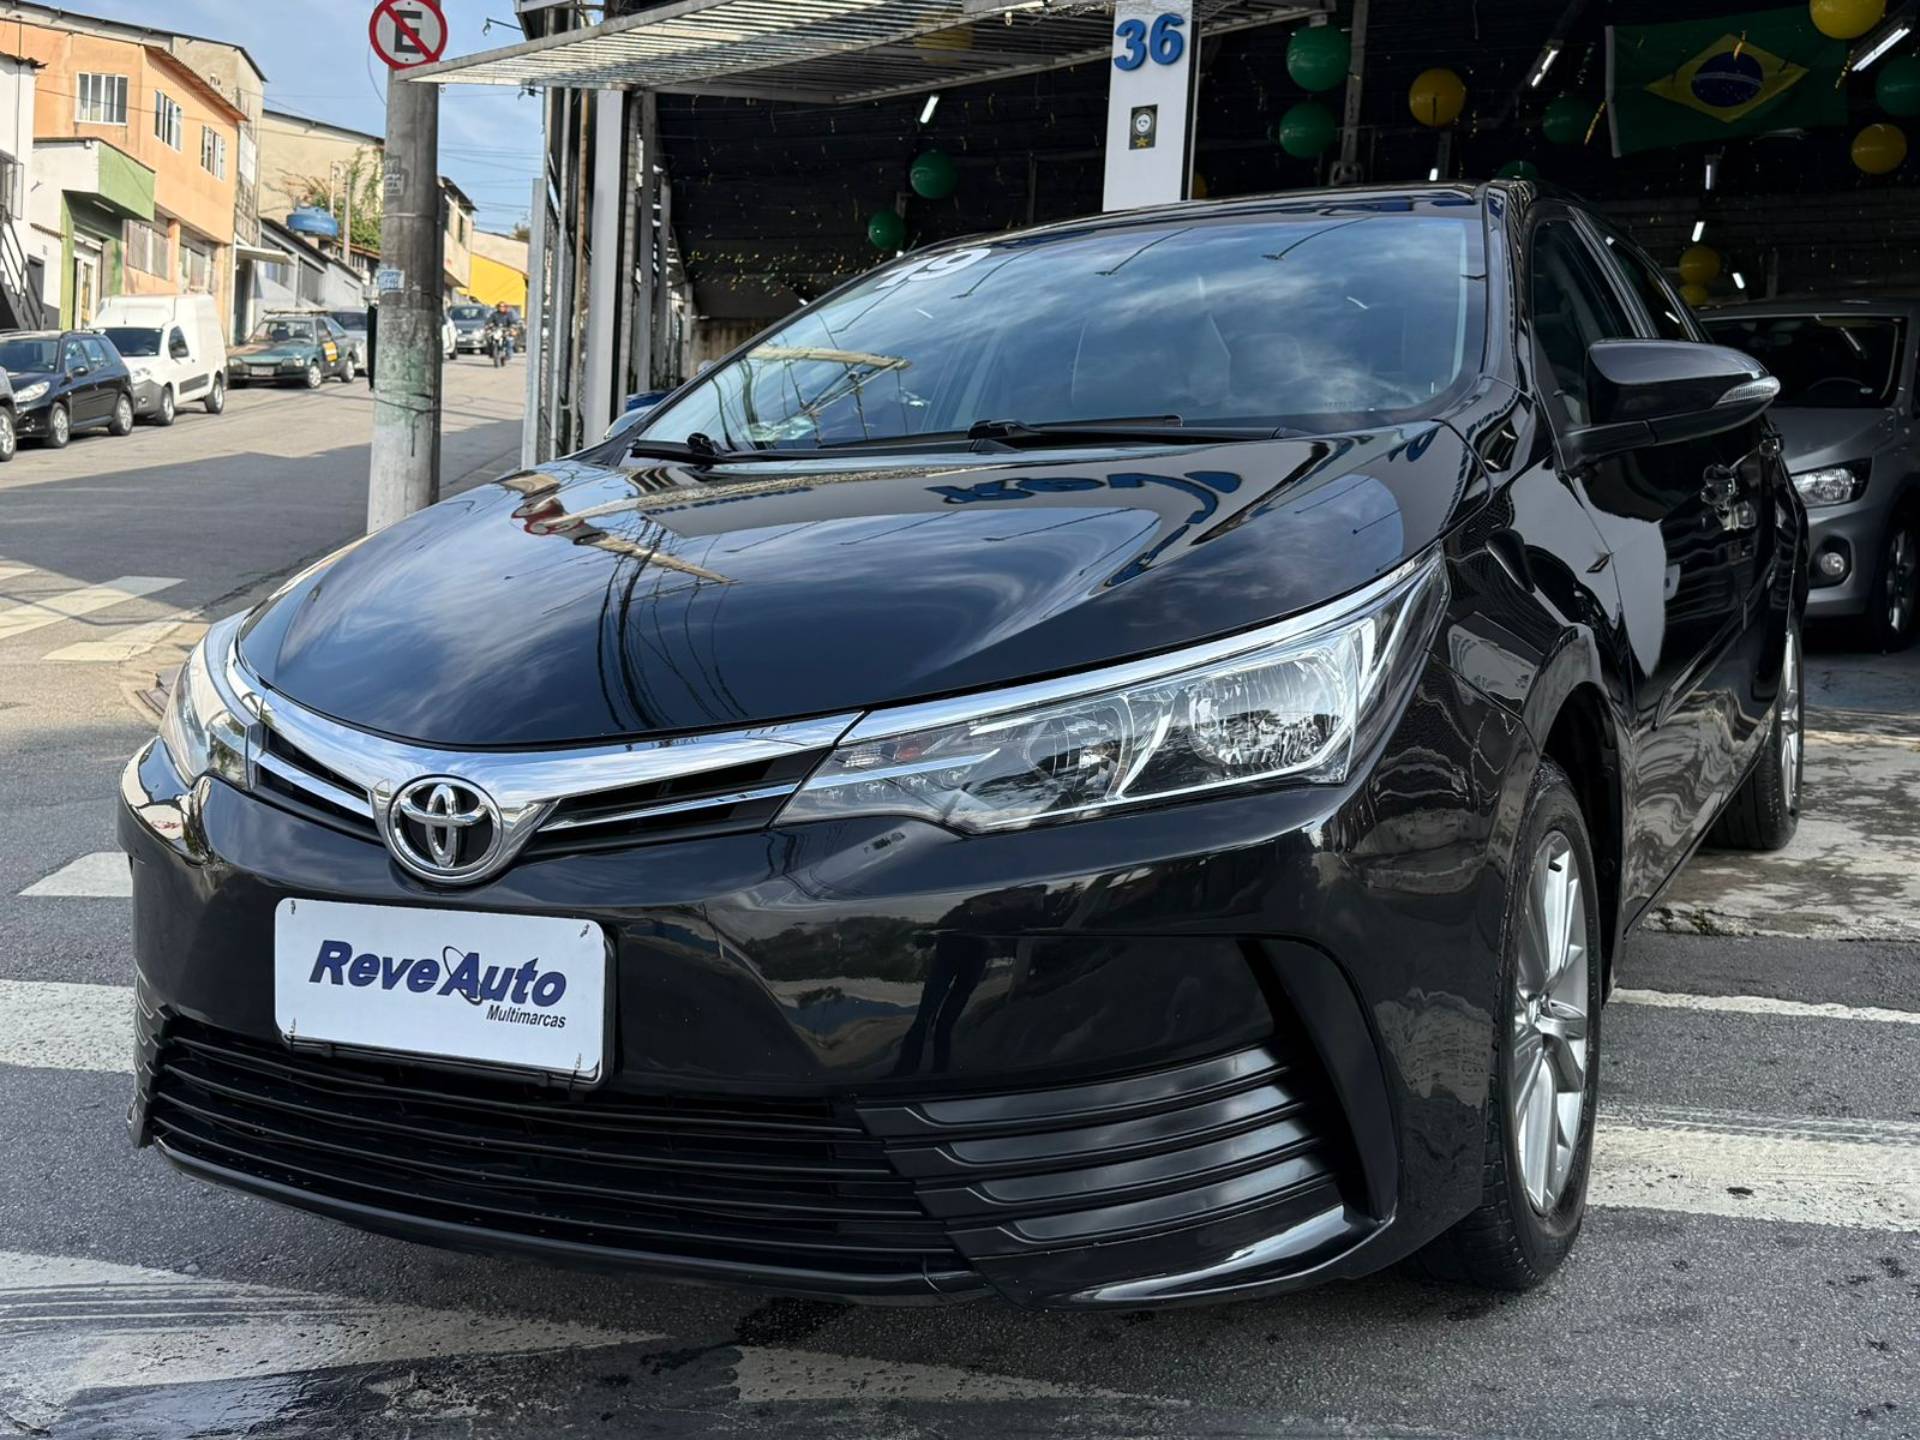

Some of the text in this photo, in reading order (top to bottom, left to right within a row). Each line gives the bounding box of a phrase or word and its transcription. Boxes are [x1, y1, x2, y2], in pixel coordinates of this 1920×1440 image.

[394, 10, 422, 54] E
[1113, 12, 1185, 72] 36
[875, 248, 992, 289] 19
[485, 1003, 567, 1029] Multimarcas
